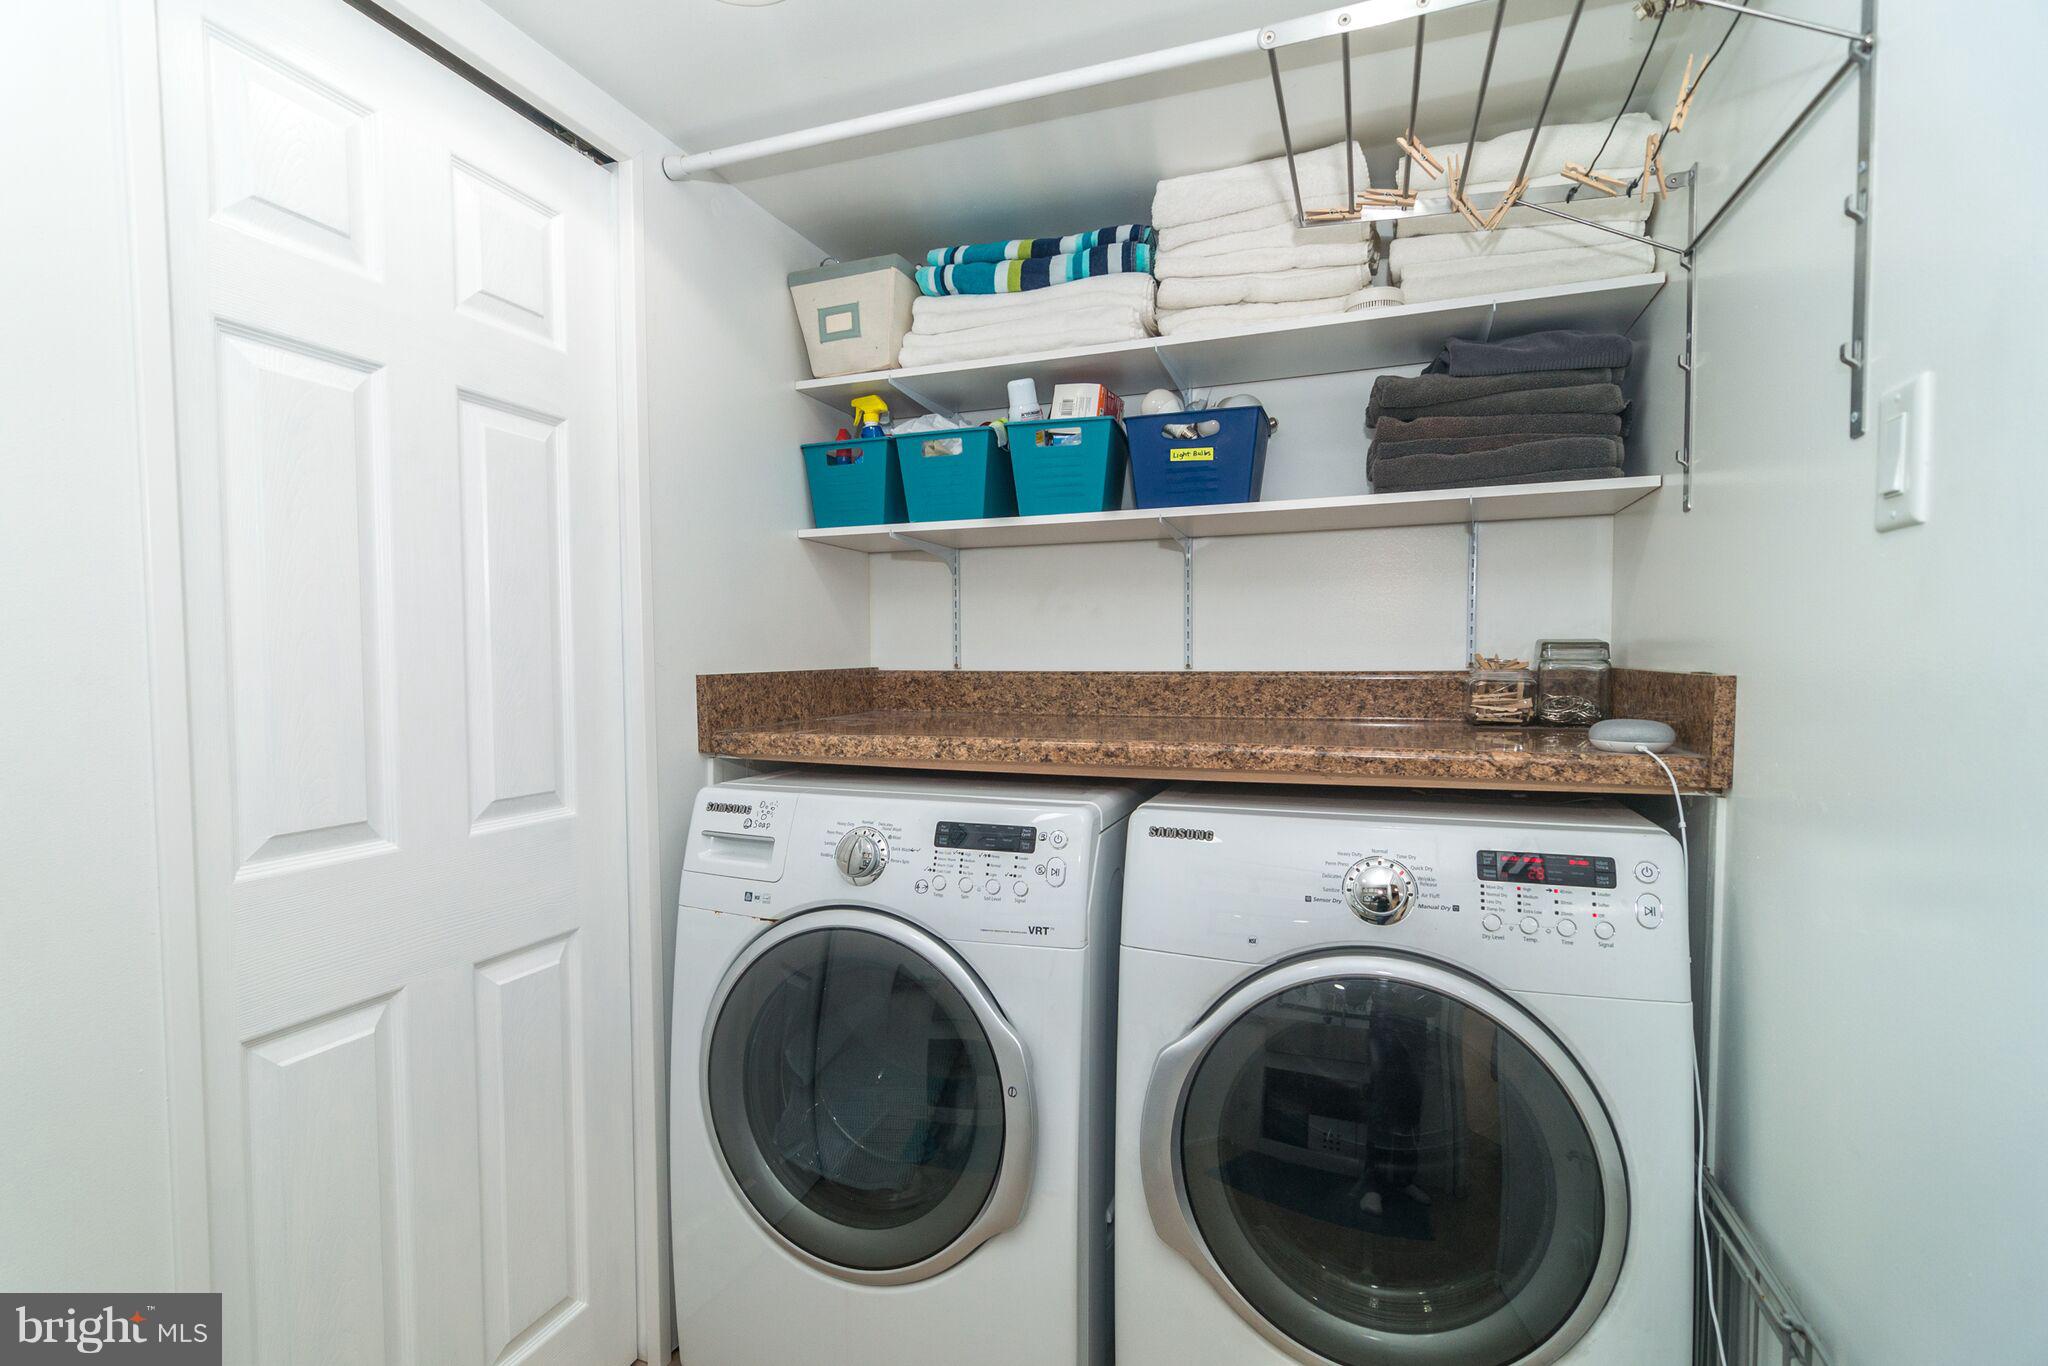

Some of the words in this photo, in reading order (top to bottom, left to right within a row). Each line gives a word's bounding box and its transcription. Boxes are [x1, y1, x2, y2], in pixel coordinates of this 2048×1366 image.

[1173, 451, 1191, 460] Light
[706, 802, 753, 815] SAMSUNG
[753, 820, 771, 830] Soap
[1149, 826, 1215, 841] SAMSUNG
[1028, 926, 1050, 935] VRT
